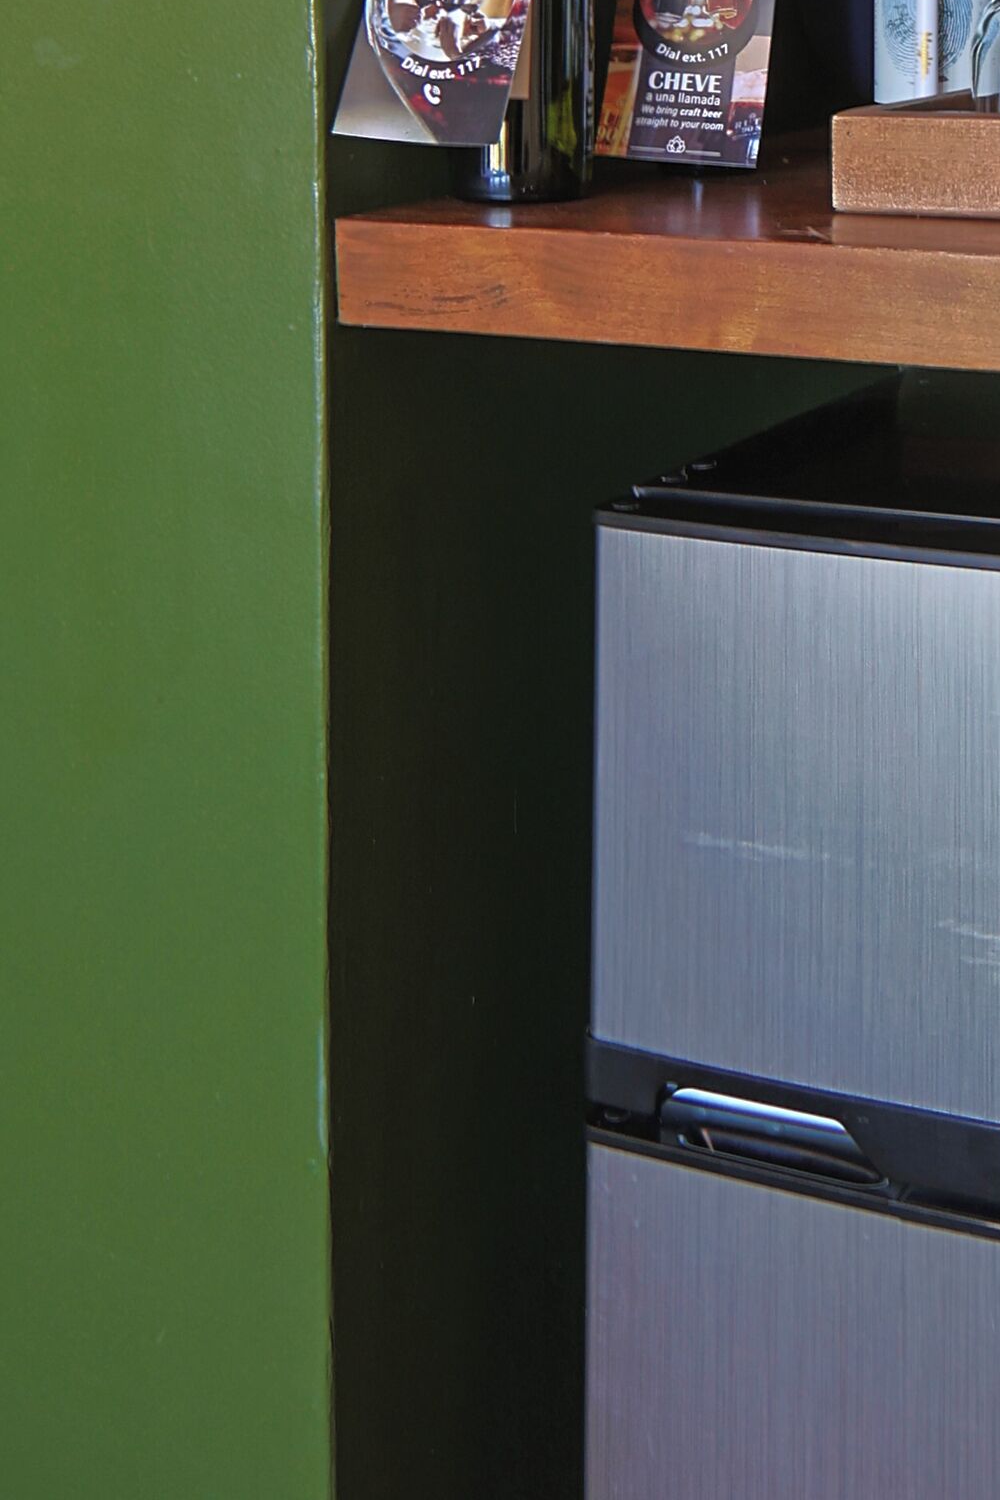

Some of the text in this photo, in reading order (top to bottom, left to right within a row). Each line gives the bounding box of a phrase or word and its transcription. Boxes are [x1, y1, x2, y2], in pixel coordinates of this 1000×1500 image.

[656, 43, 729, 63] Dial ext. 117
[401, 56, 481, 80] Dial ext. 117
[648, 70, 723, 93] CHEVE
[646, 92, 721, 106] a una llamada
[642, 104, 723, 119] We bring craft beer
[635, 117, 669, 128] straight
[669, 119, 680, 128] to
[680, 121, 701, 130] your
[701, 122, 724, 131] room
